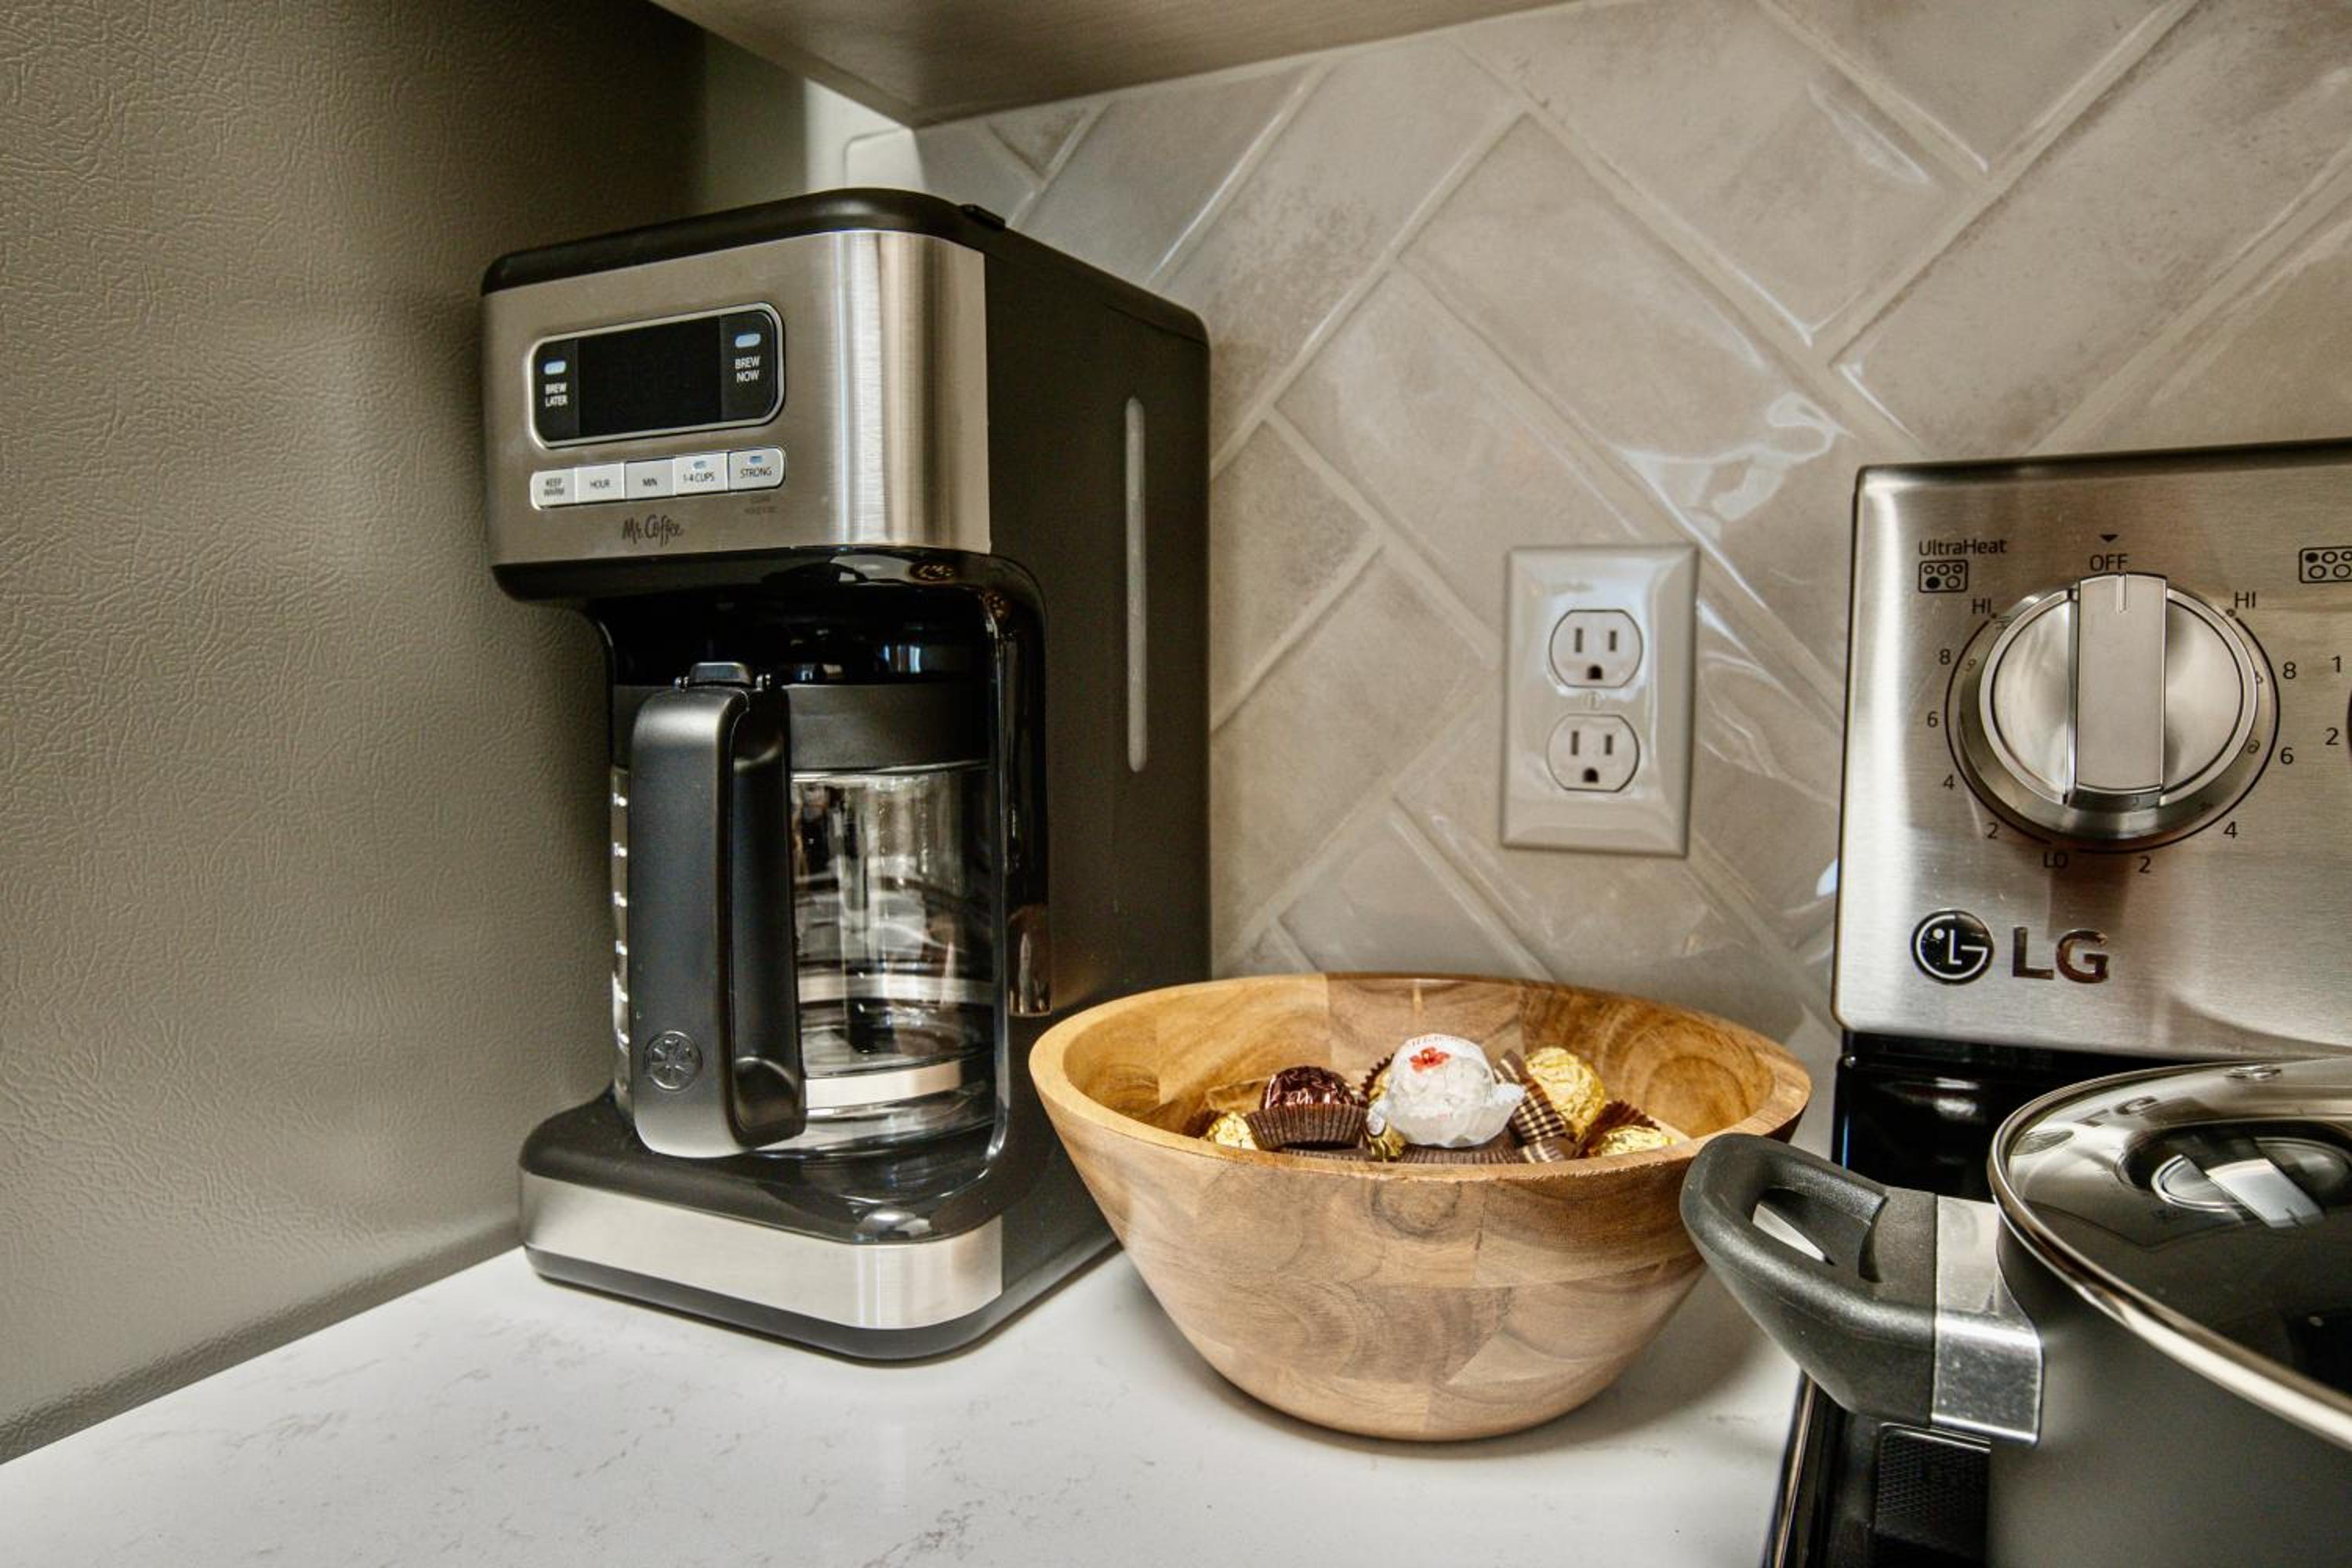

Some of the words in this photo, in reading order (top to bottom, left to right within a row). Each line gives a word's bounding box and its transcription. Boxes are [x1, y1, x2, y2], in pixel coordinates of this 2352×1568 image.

[735, 355, 760, 369] BREW
[737, 369, 760, 383] NOW
[545, 383, 567, 395] BREW
[545, 394, 568, 408] LATER
[695, 470, 715, 483] CUPS
[739, 466, 772, 479] STRONG
[590, 478, 611, 489] HOUR
[642, 477, 658, 487] MIN
[644, 514, 685, 547] Coffee
[1918, 538, 2008, 557] UltraHeat
[2089, 553, 2129, 572] OFF
[1972, 597, 1992, 615] HI
[2234, 591, 2256, 609] HI
[1939, 648, 1951, 666] 8
[2332, 655, 2343, 673] 1
[2282, 661, 2297, 680] 8
[1926, 710, 1939, 728] 6
[2325, 727, 2339, 746] 2
[2279, 746, 2295, 765] 6
[1943, 773, 1955, 790] 4
[1987, 822, 1998, 840] 2
[2223, 821, 2238, 839] 4
[2043, 851, 2069, 869] LO
[2138, 855, 2151, 874] 2
[2013, 926, 2109, 984] LG
